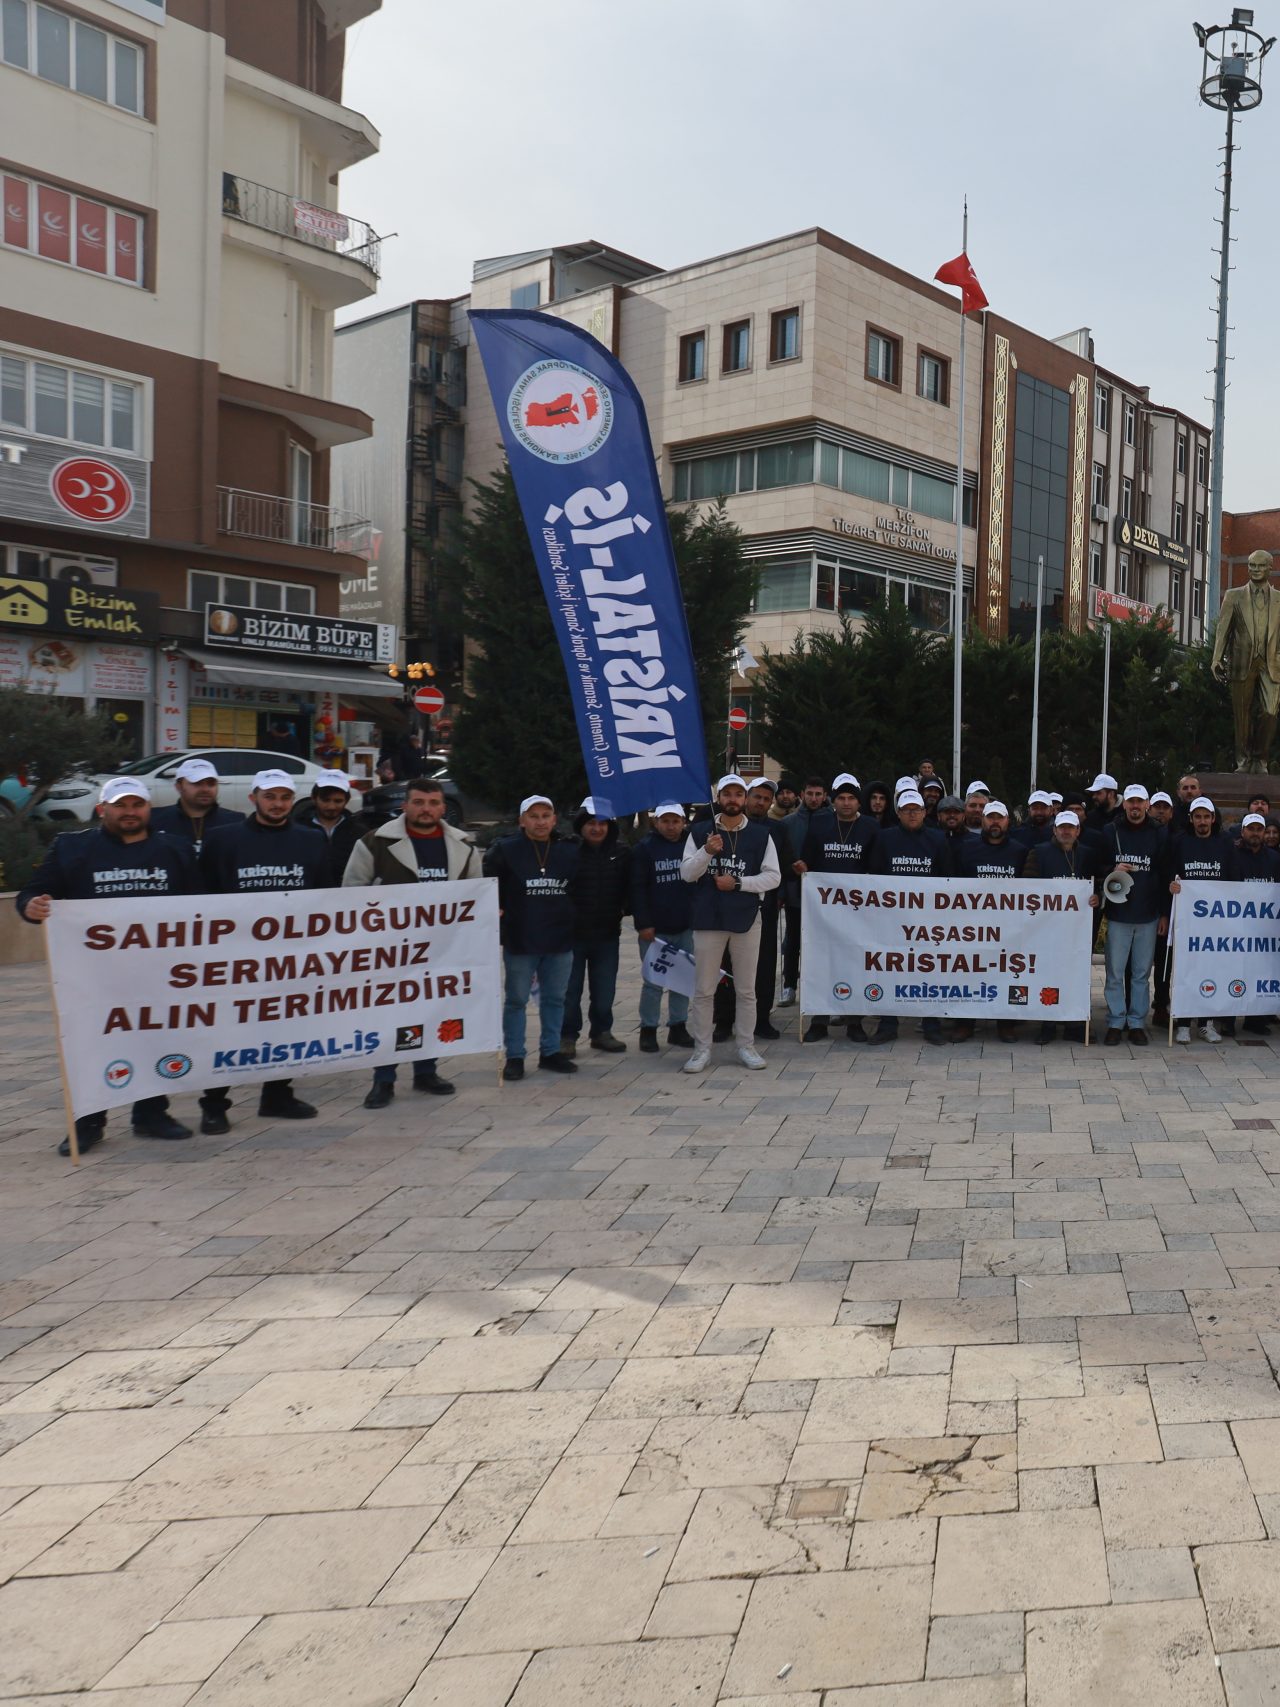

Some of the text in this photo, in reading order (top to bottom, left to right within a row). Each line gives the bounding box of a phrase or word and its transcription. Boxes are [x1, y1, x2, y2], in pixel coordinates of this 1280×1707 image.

[882, 532, 896, 545] VE
[935, 545, 959, 560] ODAS
[1134, 525, 1160, 549] DEVA
[70, 587, 136, 611] Bizim
[64, 609, 142, 633] Emlak
[243, 614, 373, 648] BİZİM BÜFE
[238, 863, 304, 880] KRİSTAL-İŞ
[655, 857, 682, 871] KRİSTA
[892, 855, 932, 867] KRİSTAL-İŞ
[1185, 860, 1221, 871] KRİSTAL-İŞ
[93, 867, 168, 883] KRİSTAL-İŞ
[239, 877, 304, 889] SENDİKASI
[656, 871, 682, 883] SENDİ
[1185, 869, 1221, 877] SENDİKASI
[95, 882, 169, 894] SENDİKASI
[817, 887, 1079, 915] YAŞASIN DAYANIŞMA
[84, 900, 476, 951] SAHİP OLDUĞUNUZ
[901, 925, 1001, 946] YAŞASIN
[169, 938, 431, 989] SERMAYENİZ
[864, 947, 1036, 979] KRİSTAL-İŞ!
[103, 970, 472, 1035] ALIN TERİMİZDİR!
[895, 981, 998, 1002] KRİSTAL-İŞ
[213, 1030, 380, 1070] KRİSTAL-İŞ
